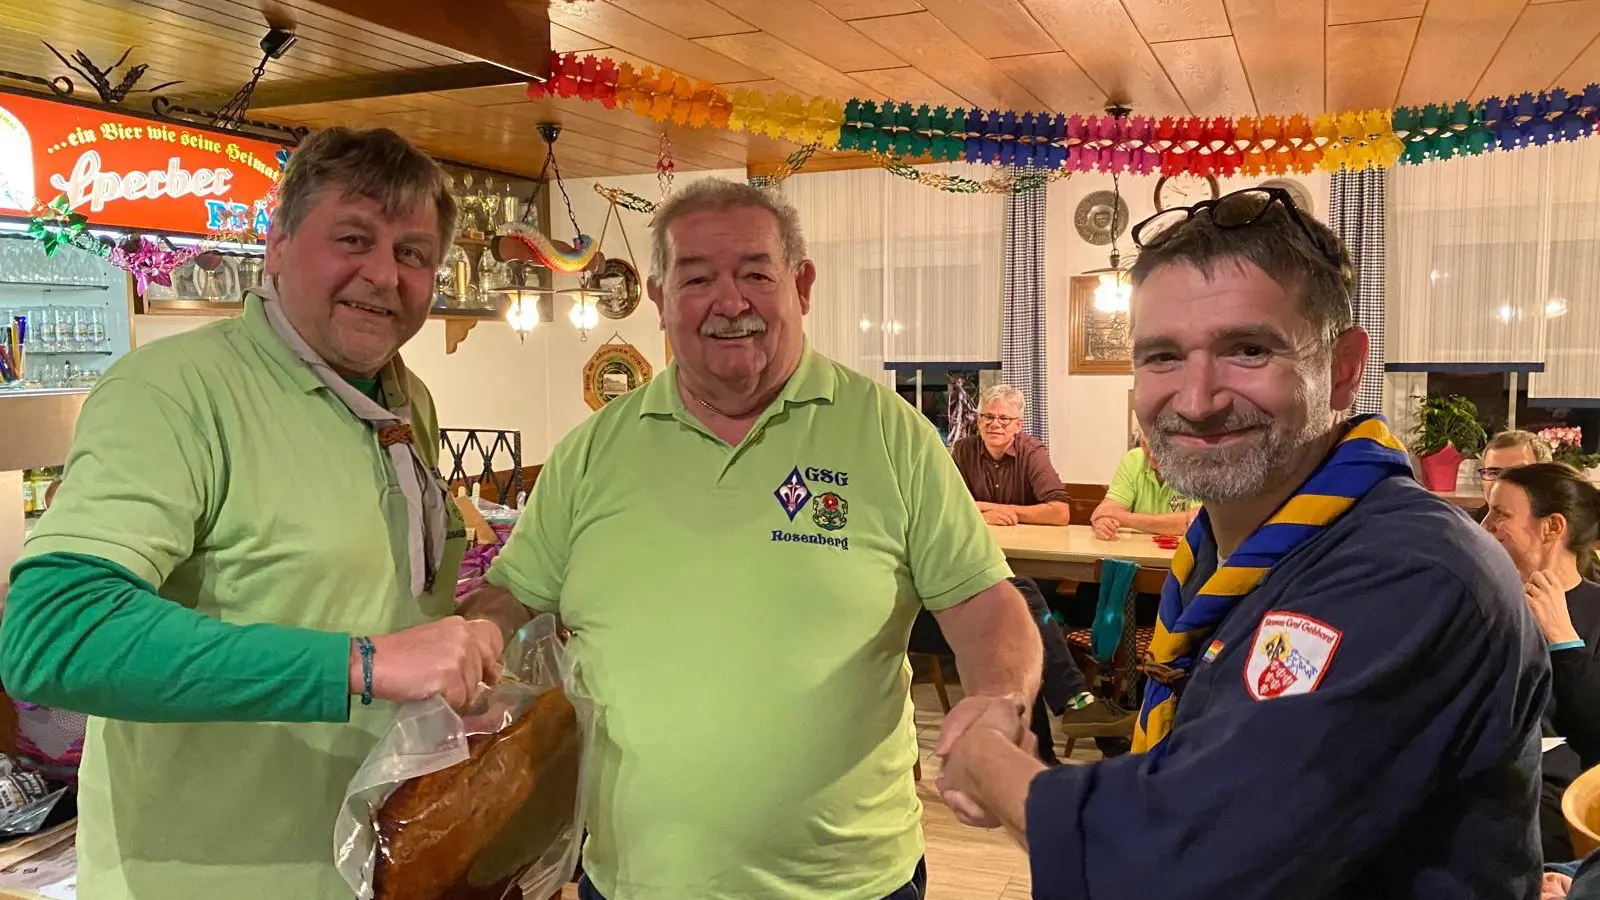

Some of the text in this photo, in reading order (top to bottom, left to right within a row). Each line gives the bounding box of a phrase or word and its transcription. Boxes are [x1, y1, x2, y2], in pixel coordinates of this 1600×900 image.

[100, 123, 143, 141] Bier
[147, 125, 177, 143] wie
[180, 131, 222, 154] seine
[226, 143, 280, 181] Heimat
[50, 149, 234, 212] Sperber
[205, 198, 270, 234] BRÄ
[804, 466, 849, 487] GSG
[771, 529, 849, 551] Rosenberg
